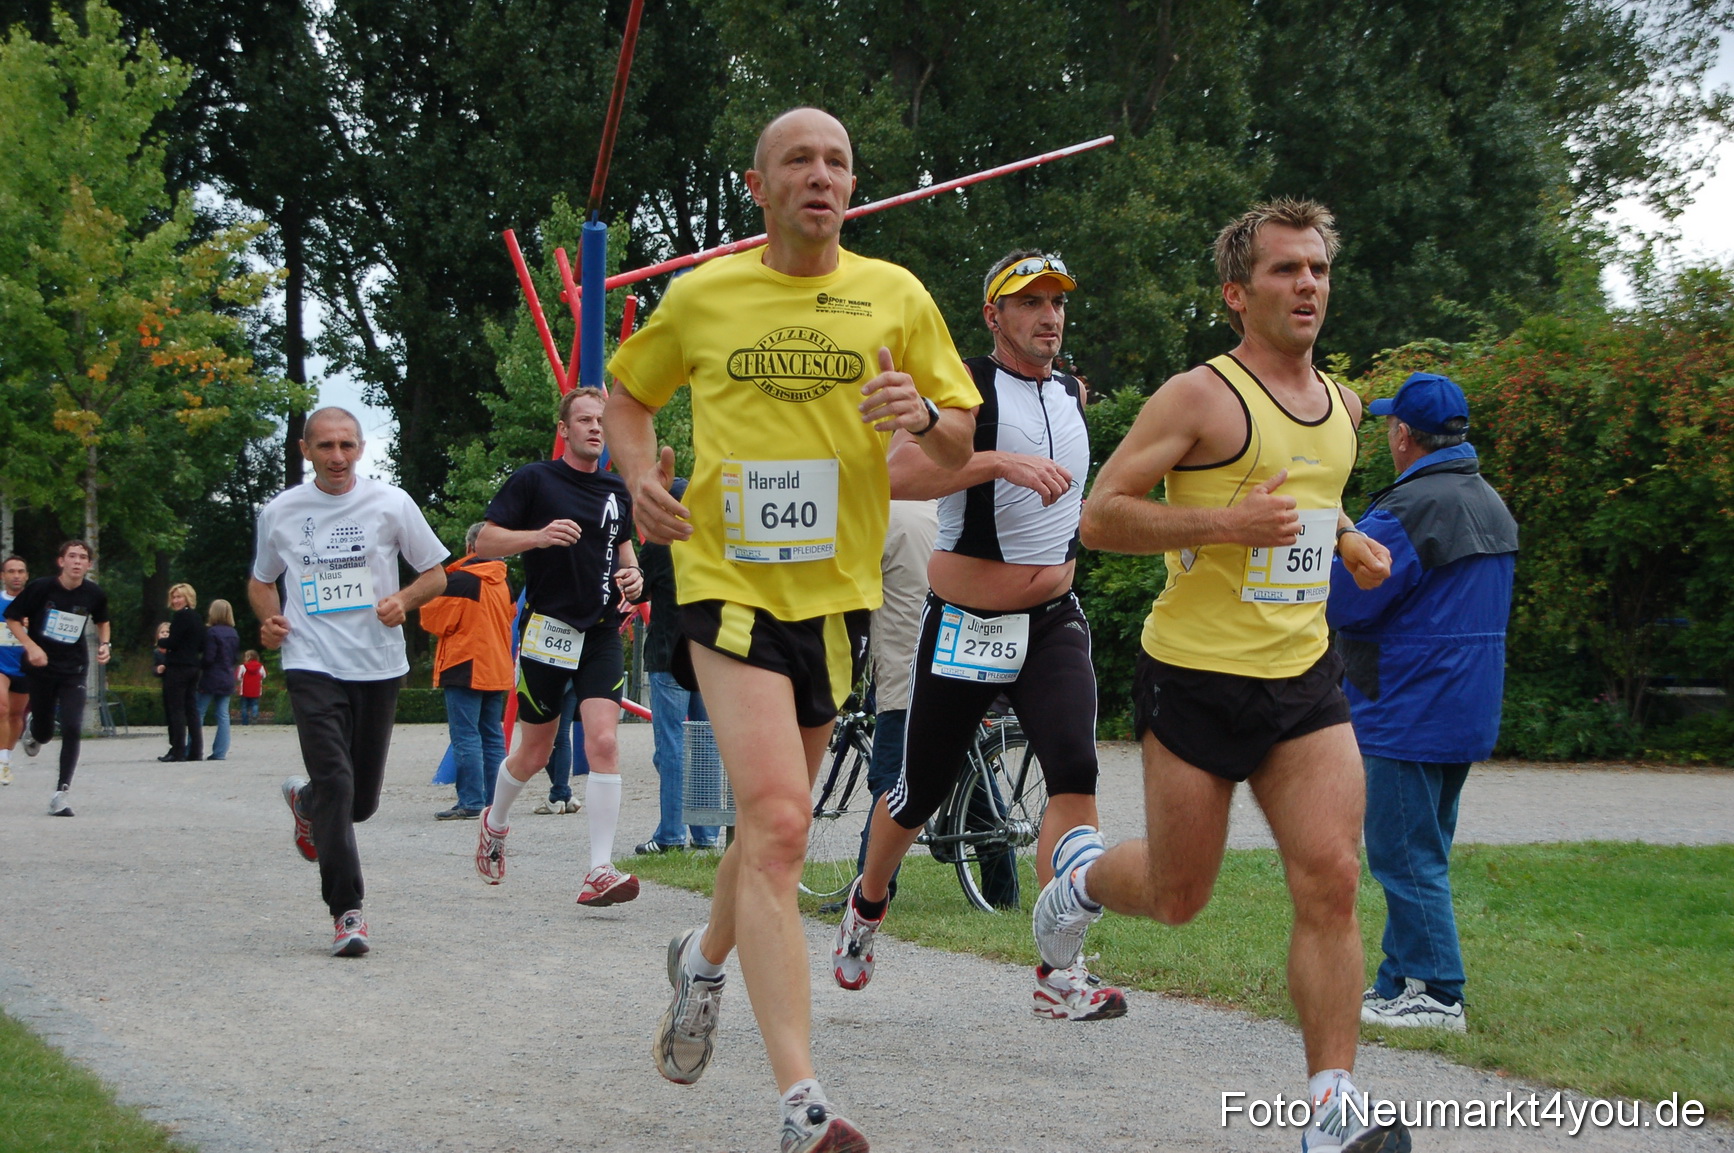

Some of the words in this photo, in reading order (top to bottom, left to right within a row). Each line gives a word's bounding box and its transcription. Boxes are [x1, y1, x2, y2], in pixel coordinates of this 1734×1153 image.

[848, 299, 871, 307] WAGNER
[759, 329, 832, 352] PIZZERIA
[744, 353, 848, 378] FRANCESCO
[760, 380, 831, 401] HERSBRUCK
[748, 470, 800, 490] Harald
[725, 499, 731, 513] A
[761, 501, 817, 529] 640
[793, 544, 833, 555] PFLEIDERER
[317, 555, 365, 565] Neumarkter
[329, 560, 366, 571] Stadtlauf
[1286, 546, 1322, 572] 561
[319, 571, 342, 581] Klaus
[322, 583, 362, 601] 3171
[57, 622, 79, 633] 3239
[544, 620, 571, 635] Thomas
[545, 636, 572, 652] 648
[944, 632, 950, 642] A
[963, 639, 1017, 660] 2785
